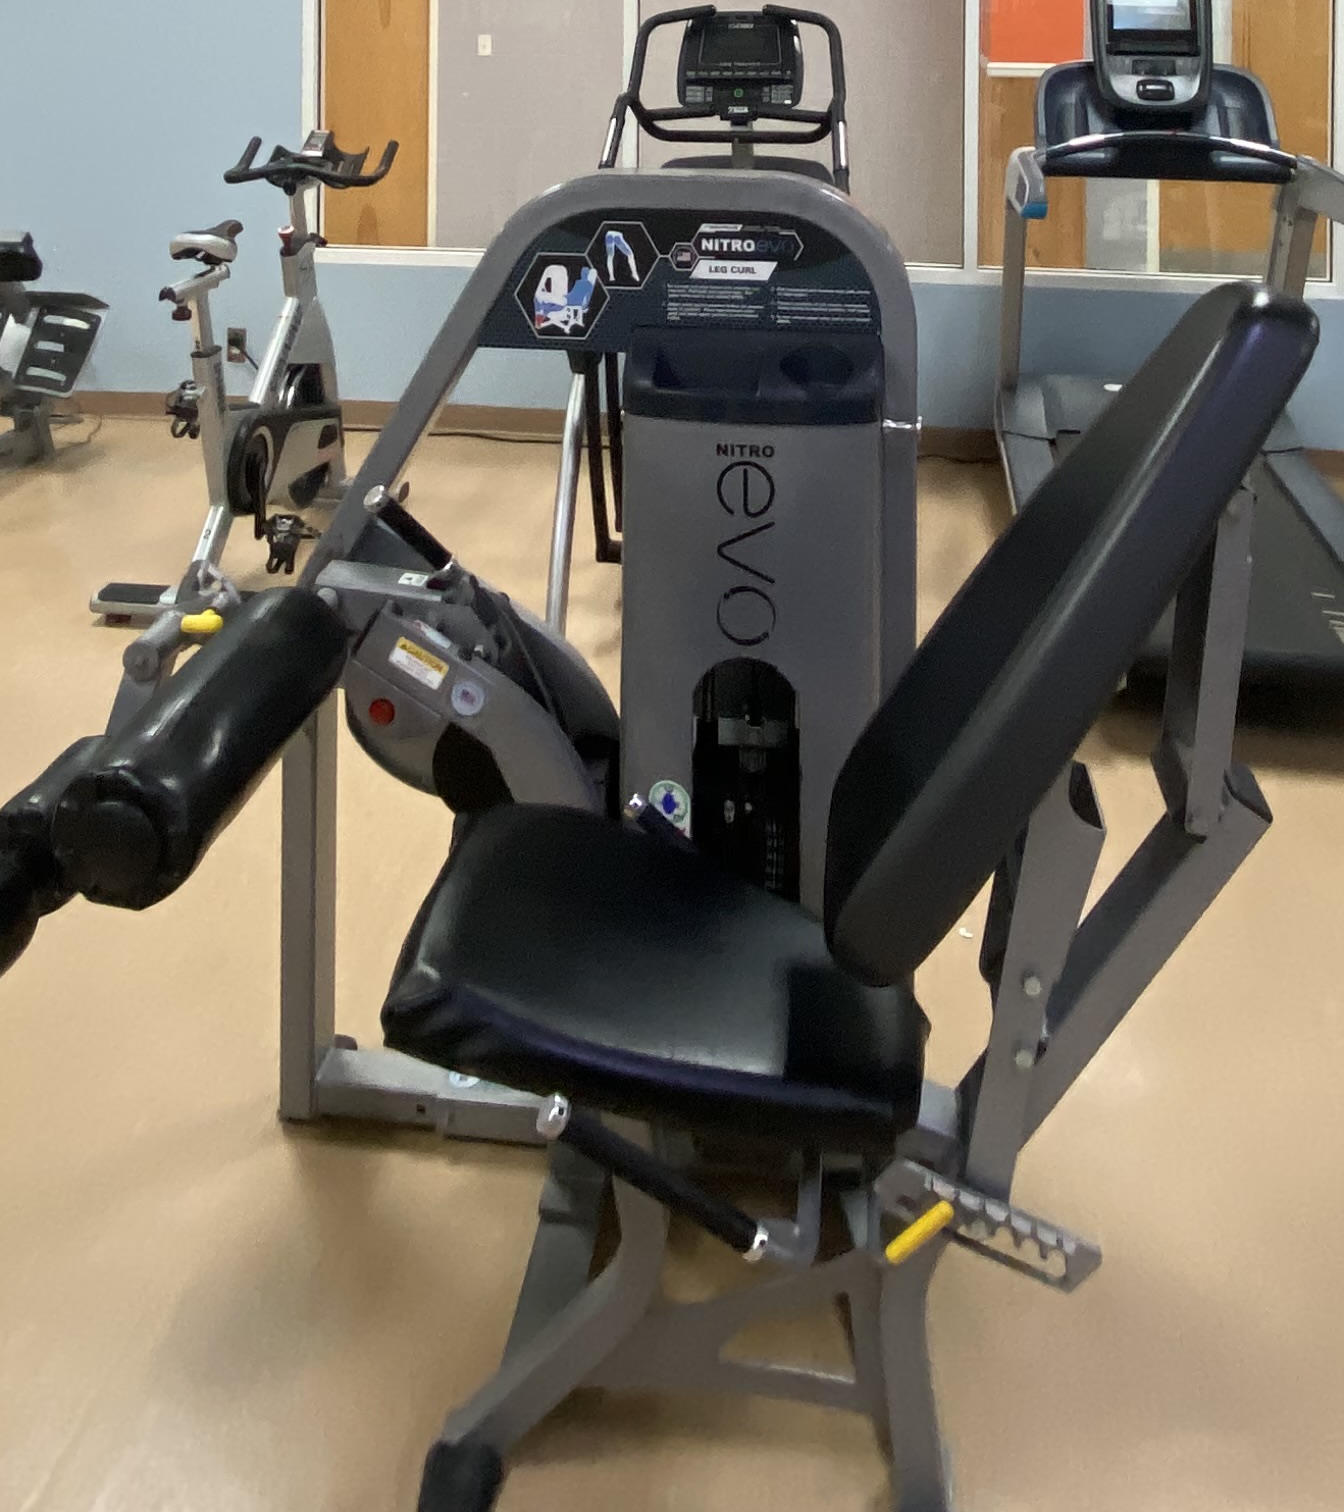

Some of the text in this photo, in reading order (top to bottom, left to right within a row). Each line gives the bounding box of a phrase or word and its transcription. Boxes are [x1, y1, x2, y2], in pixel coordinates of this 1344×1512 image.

[708, 264, 757, 275] LEG CURL
[716, 443, 775, 458] NITRO
[203, 528, 211, 540] 2
[716, 460, 777, 647] evo
